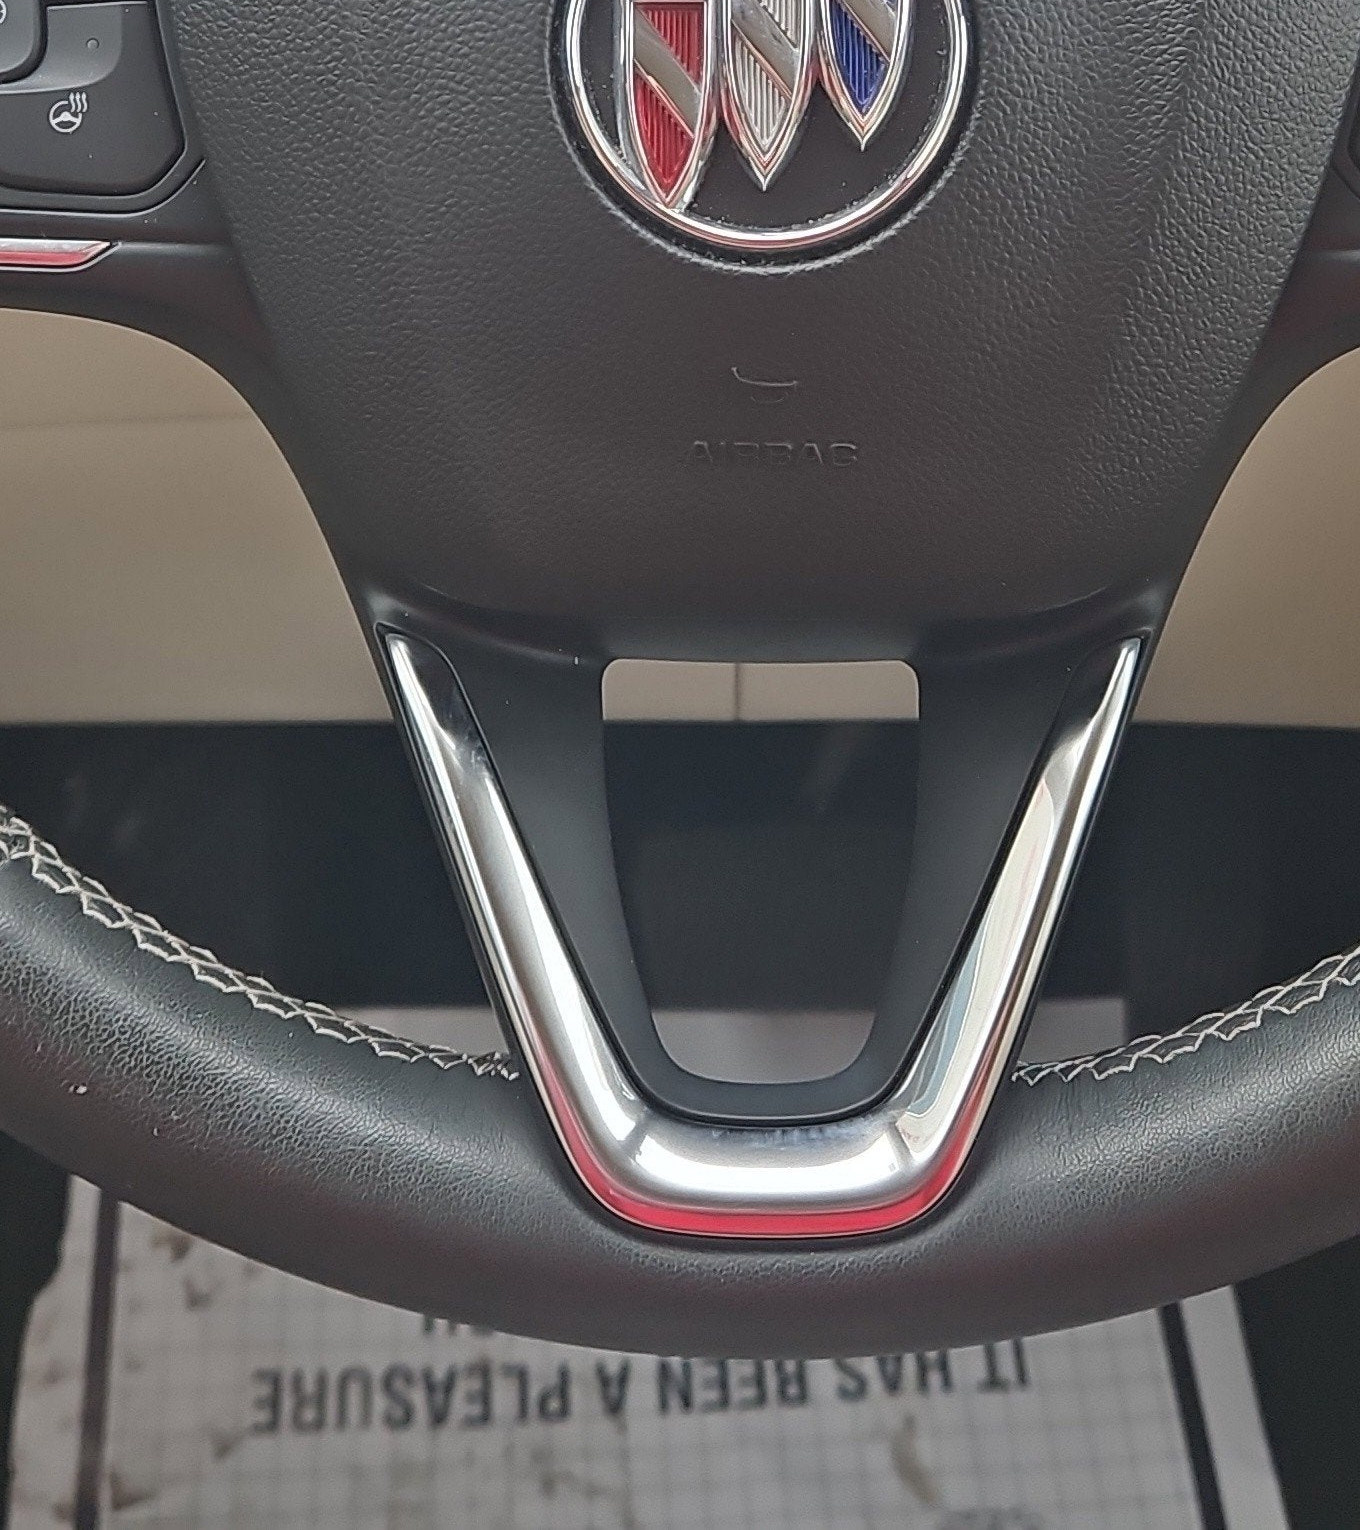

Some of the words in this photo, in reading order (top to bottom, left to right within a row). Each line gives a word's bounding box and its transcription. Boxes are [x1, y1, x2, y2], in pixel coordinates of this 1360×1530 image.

[250, 1356, 571, 1433] PLEASURE
[595, 1356, 631, 1417] A
[835, 1350, 953, 1403] HAS
[977, 1338, 1031, 1393] IT
